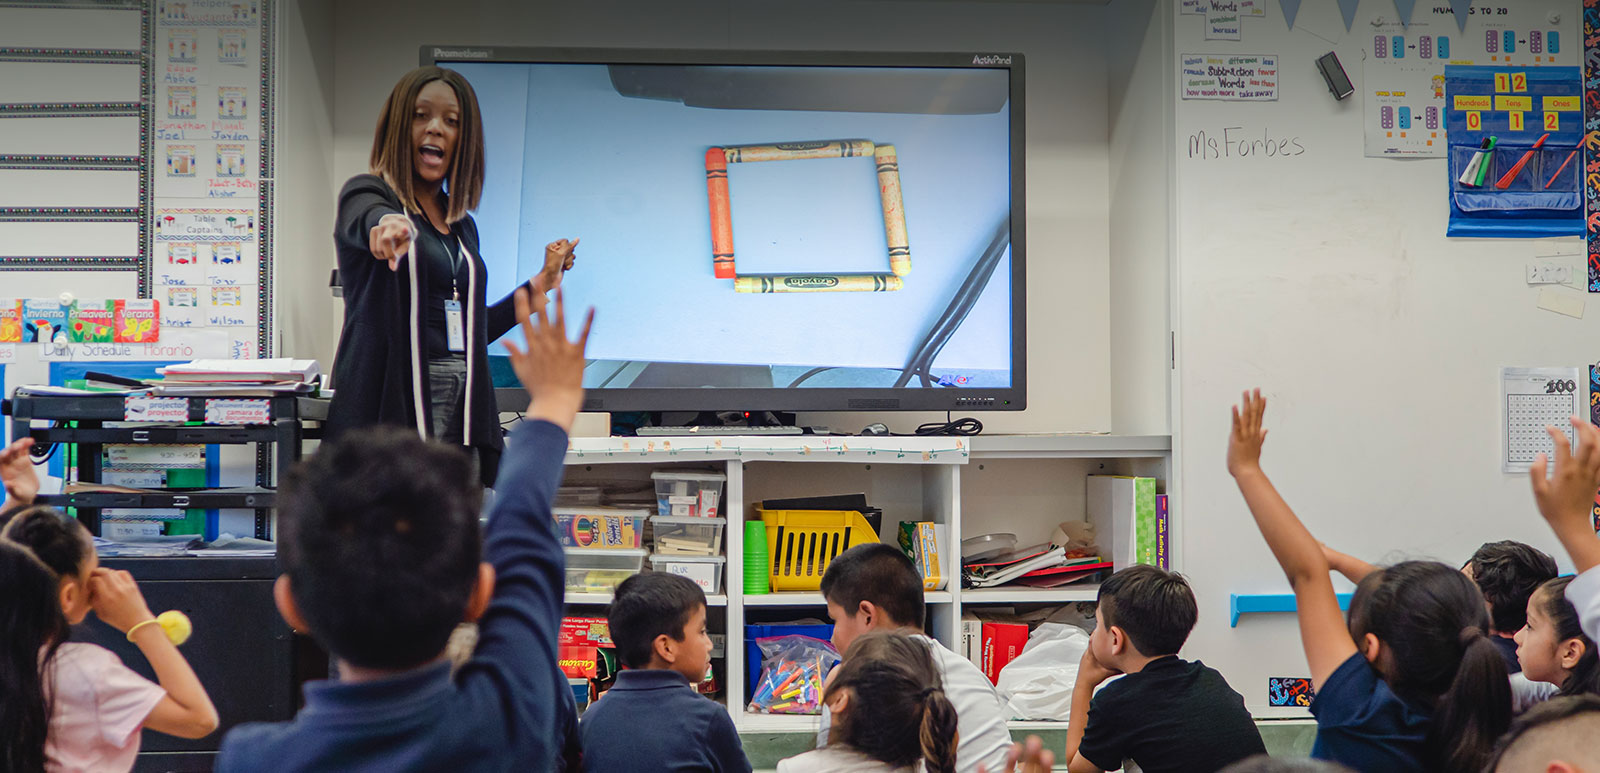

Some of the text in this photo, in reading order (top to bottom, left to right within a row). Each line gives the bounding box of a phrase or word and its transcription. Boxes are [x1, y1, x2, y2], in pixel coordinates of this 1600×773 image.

[1210, 0, 1238, 12] Words
[1432, 7, 1508, 15] NUMS TO 20
[433, 48, 488, 58] Promethean
[1207, 65, 1255, 77] Subtraction
[1218, 77, 1246, 89] Words
[1186, 88, 1200, 96] how
[1456, 98, 1490, 108] Hundreds
[1505, 99, 1522, 108] Tens
[1552, 99, 1571, 108] Ones
[1468, 113, 1479, 129] 0
[1513, 113, 1521, 128] 1
[1546, 113, 1557, 129] 2
[157, 129, 185, 140] Joel
[1188, 126, 1305, 160] Ms Forbes
[194, 215, 216, 223] Table
[790, 277, 835, 287] Crayola
[27, 308, 65, 318] Invierno
[69, 308, 114, 319] Primavera
[120, 308, 155, 319] Verano
[82, 342, 132, 357] Schedule
[144, 343, 193, 357] Horario
[149, 401, 186, 410] projector
[147, 409, 186, 418] proyector
[604, 515, 615, 546] Colored
[612, 516, 623, 545] Pencils
[558, 659, 595, 671] Curious
